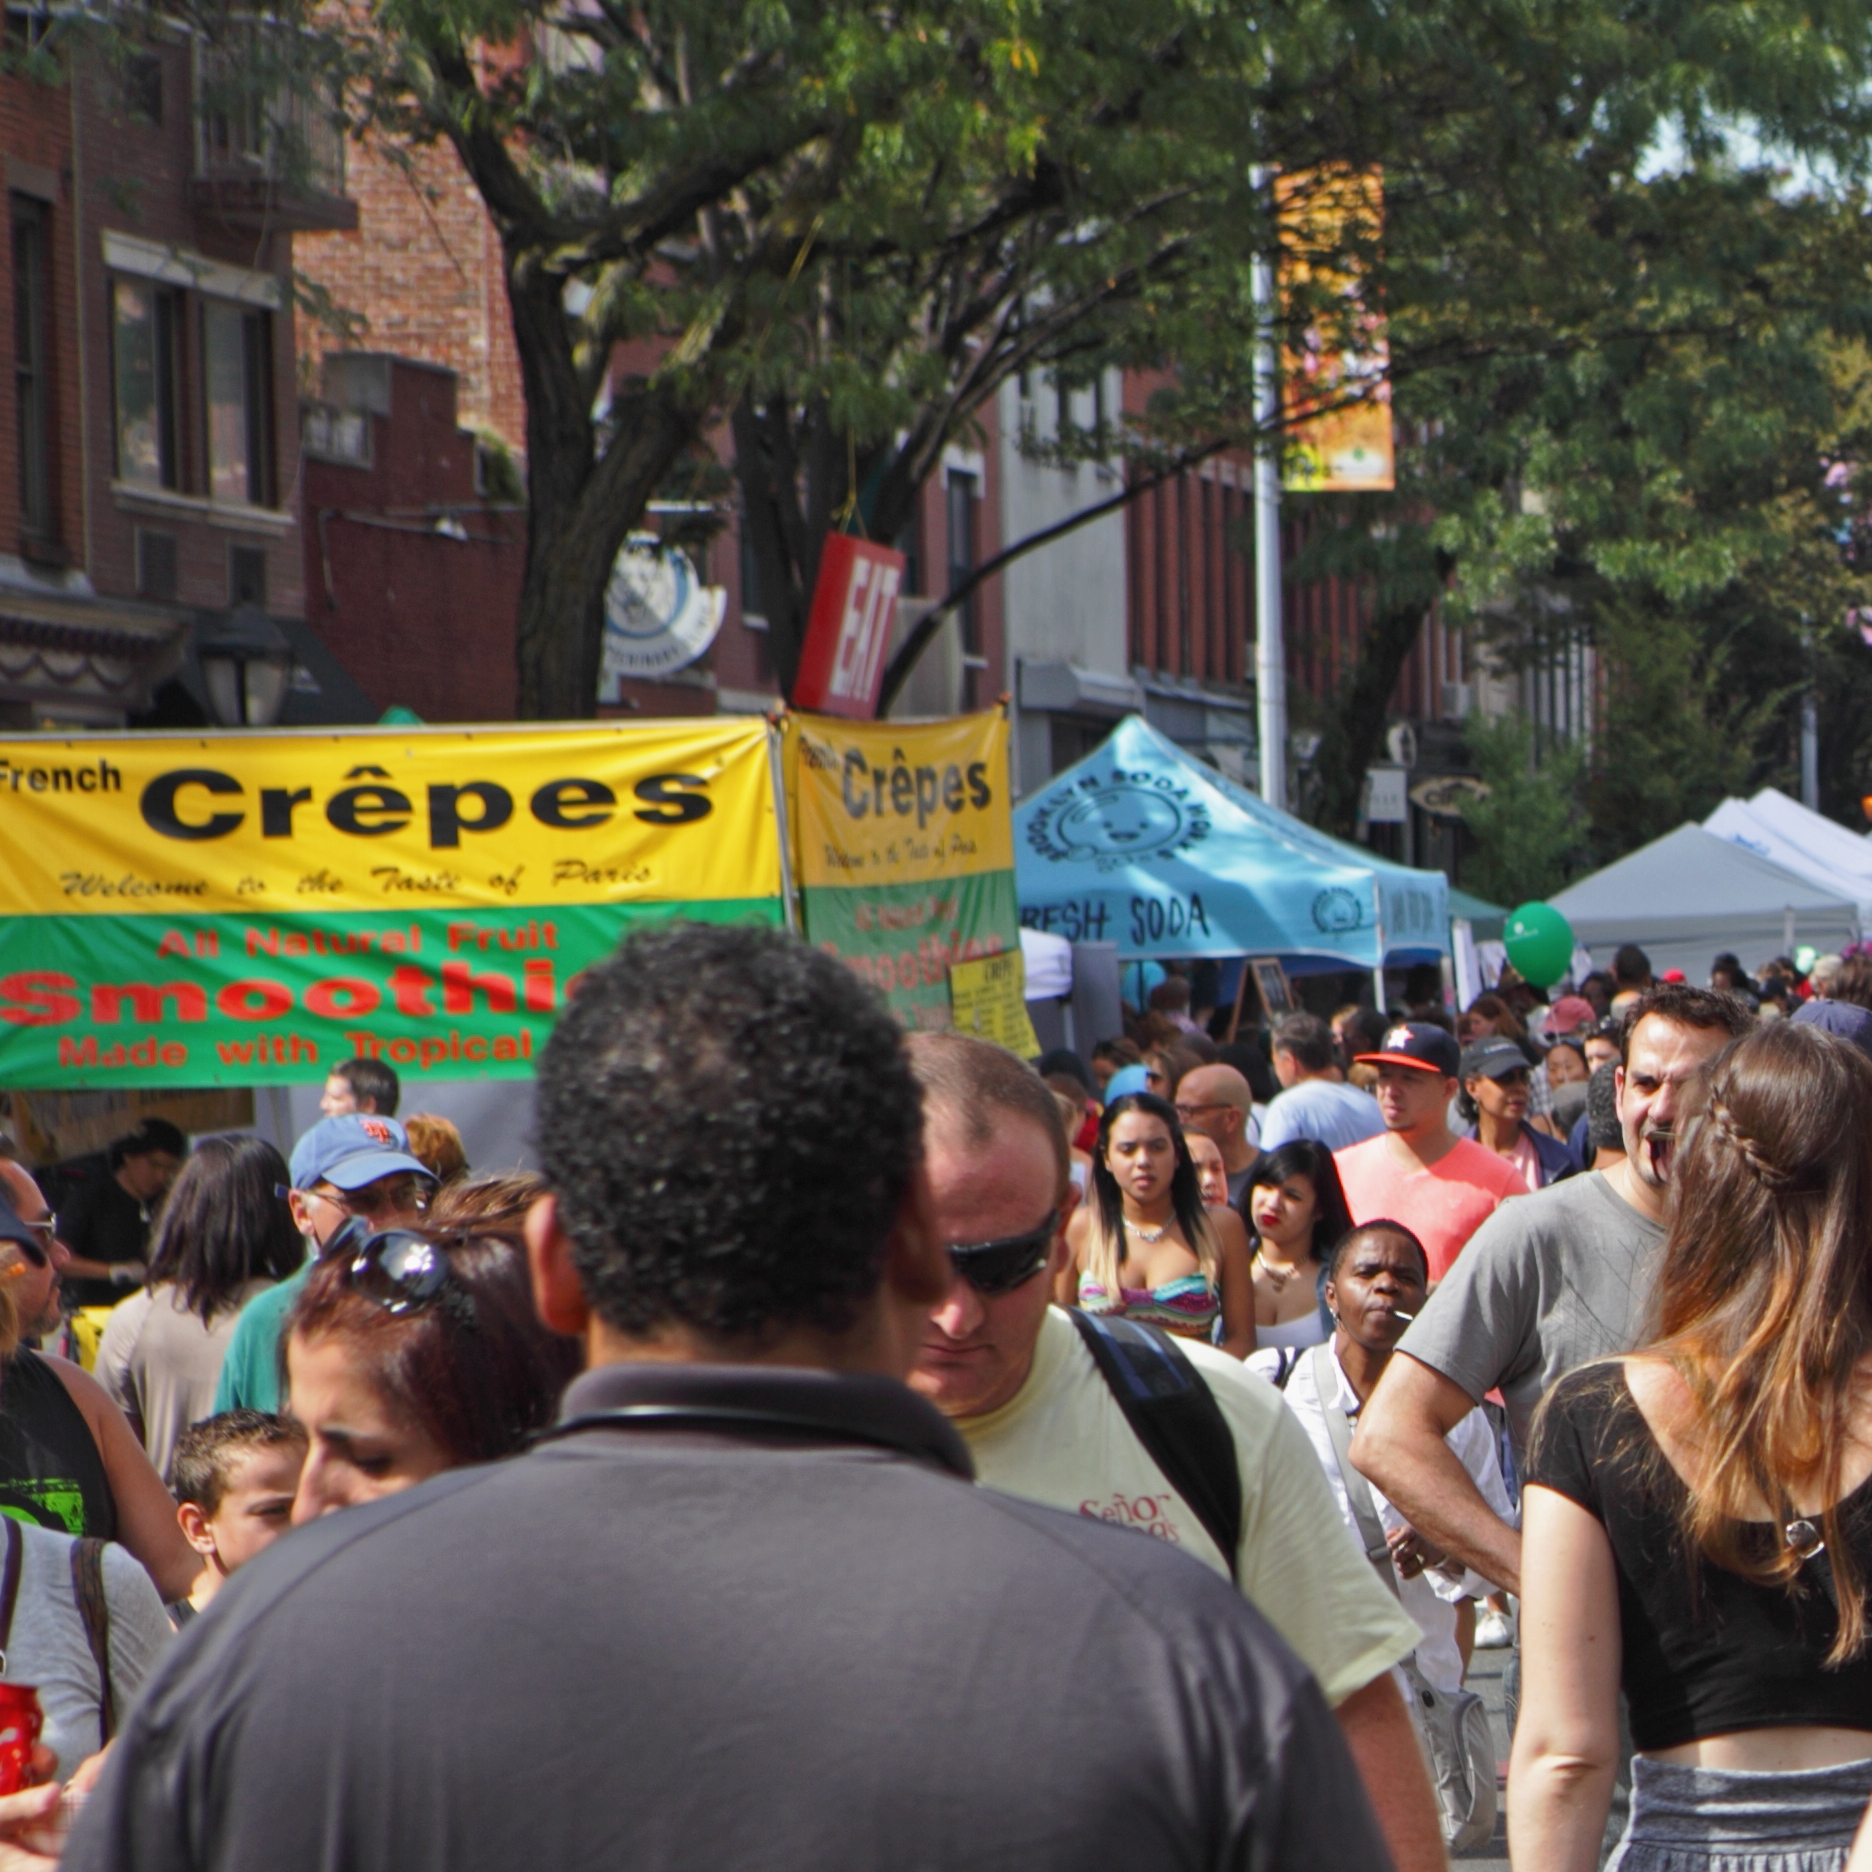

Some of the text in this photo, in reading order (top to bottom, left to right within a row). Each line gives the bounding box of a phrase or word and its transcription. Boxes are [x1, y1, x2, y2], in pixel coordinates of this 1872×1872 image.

[829, 555, 901, 702] EAT
[139, 765, 713, 850] Crêpes
[842, 748, 991, 830] Crêpes
[58, 859, 652, 898] Welcome to the Taste of Paris
[156, 920, 559, 959] All Natural Fruit
[1020, 892, 1210, 947] RESH SODA
[0, 958, 590, 1026] Smoothi
[58, 1027, 533, 1071] Made with Tropical
[1079, 1492, 1171, 1526] Señor
